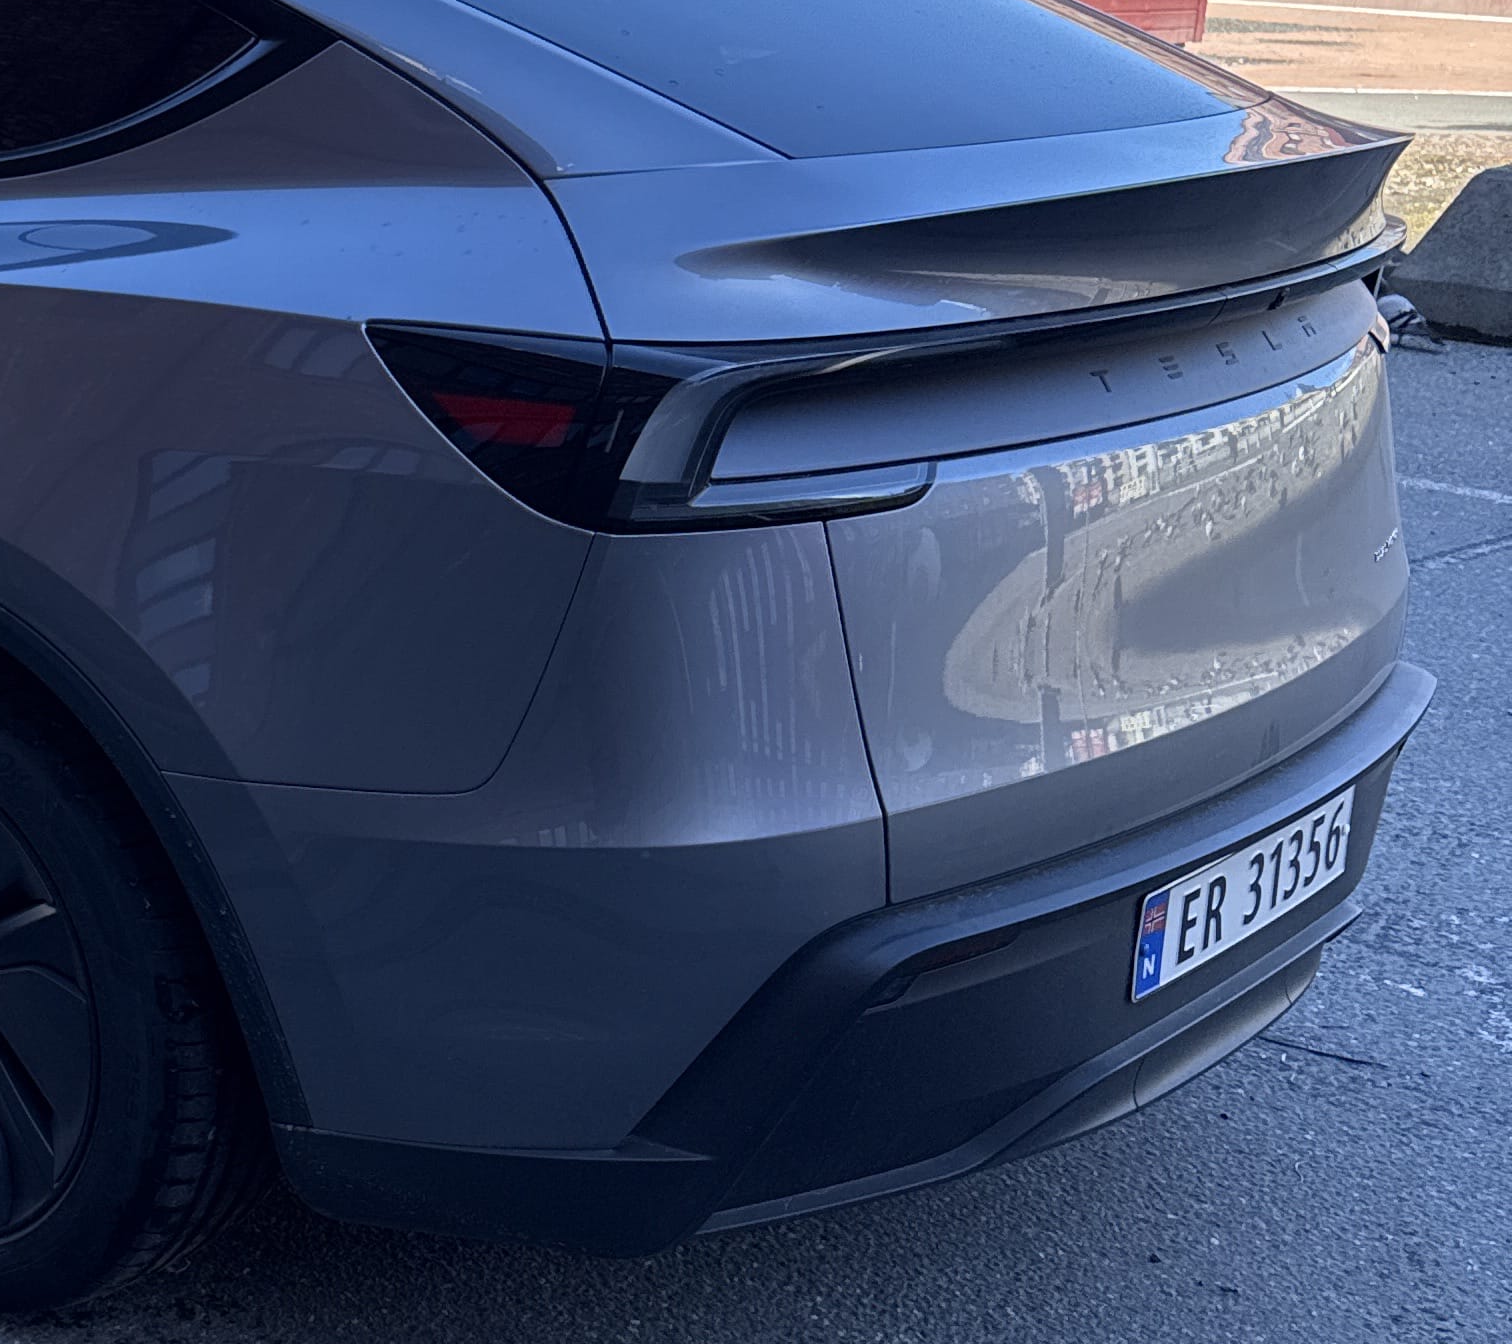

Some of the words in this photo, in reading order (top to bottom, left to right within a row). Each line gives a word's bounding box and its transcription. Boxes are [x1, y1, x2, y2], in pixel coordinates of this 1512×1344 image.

[1089, 315, 1317, 394] TESLA
[1176, 875, 1227, 965] ER
[1242, 800, 1345, 926] 31356
[1142, 954, 1156, 980] N
